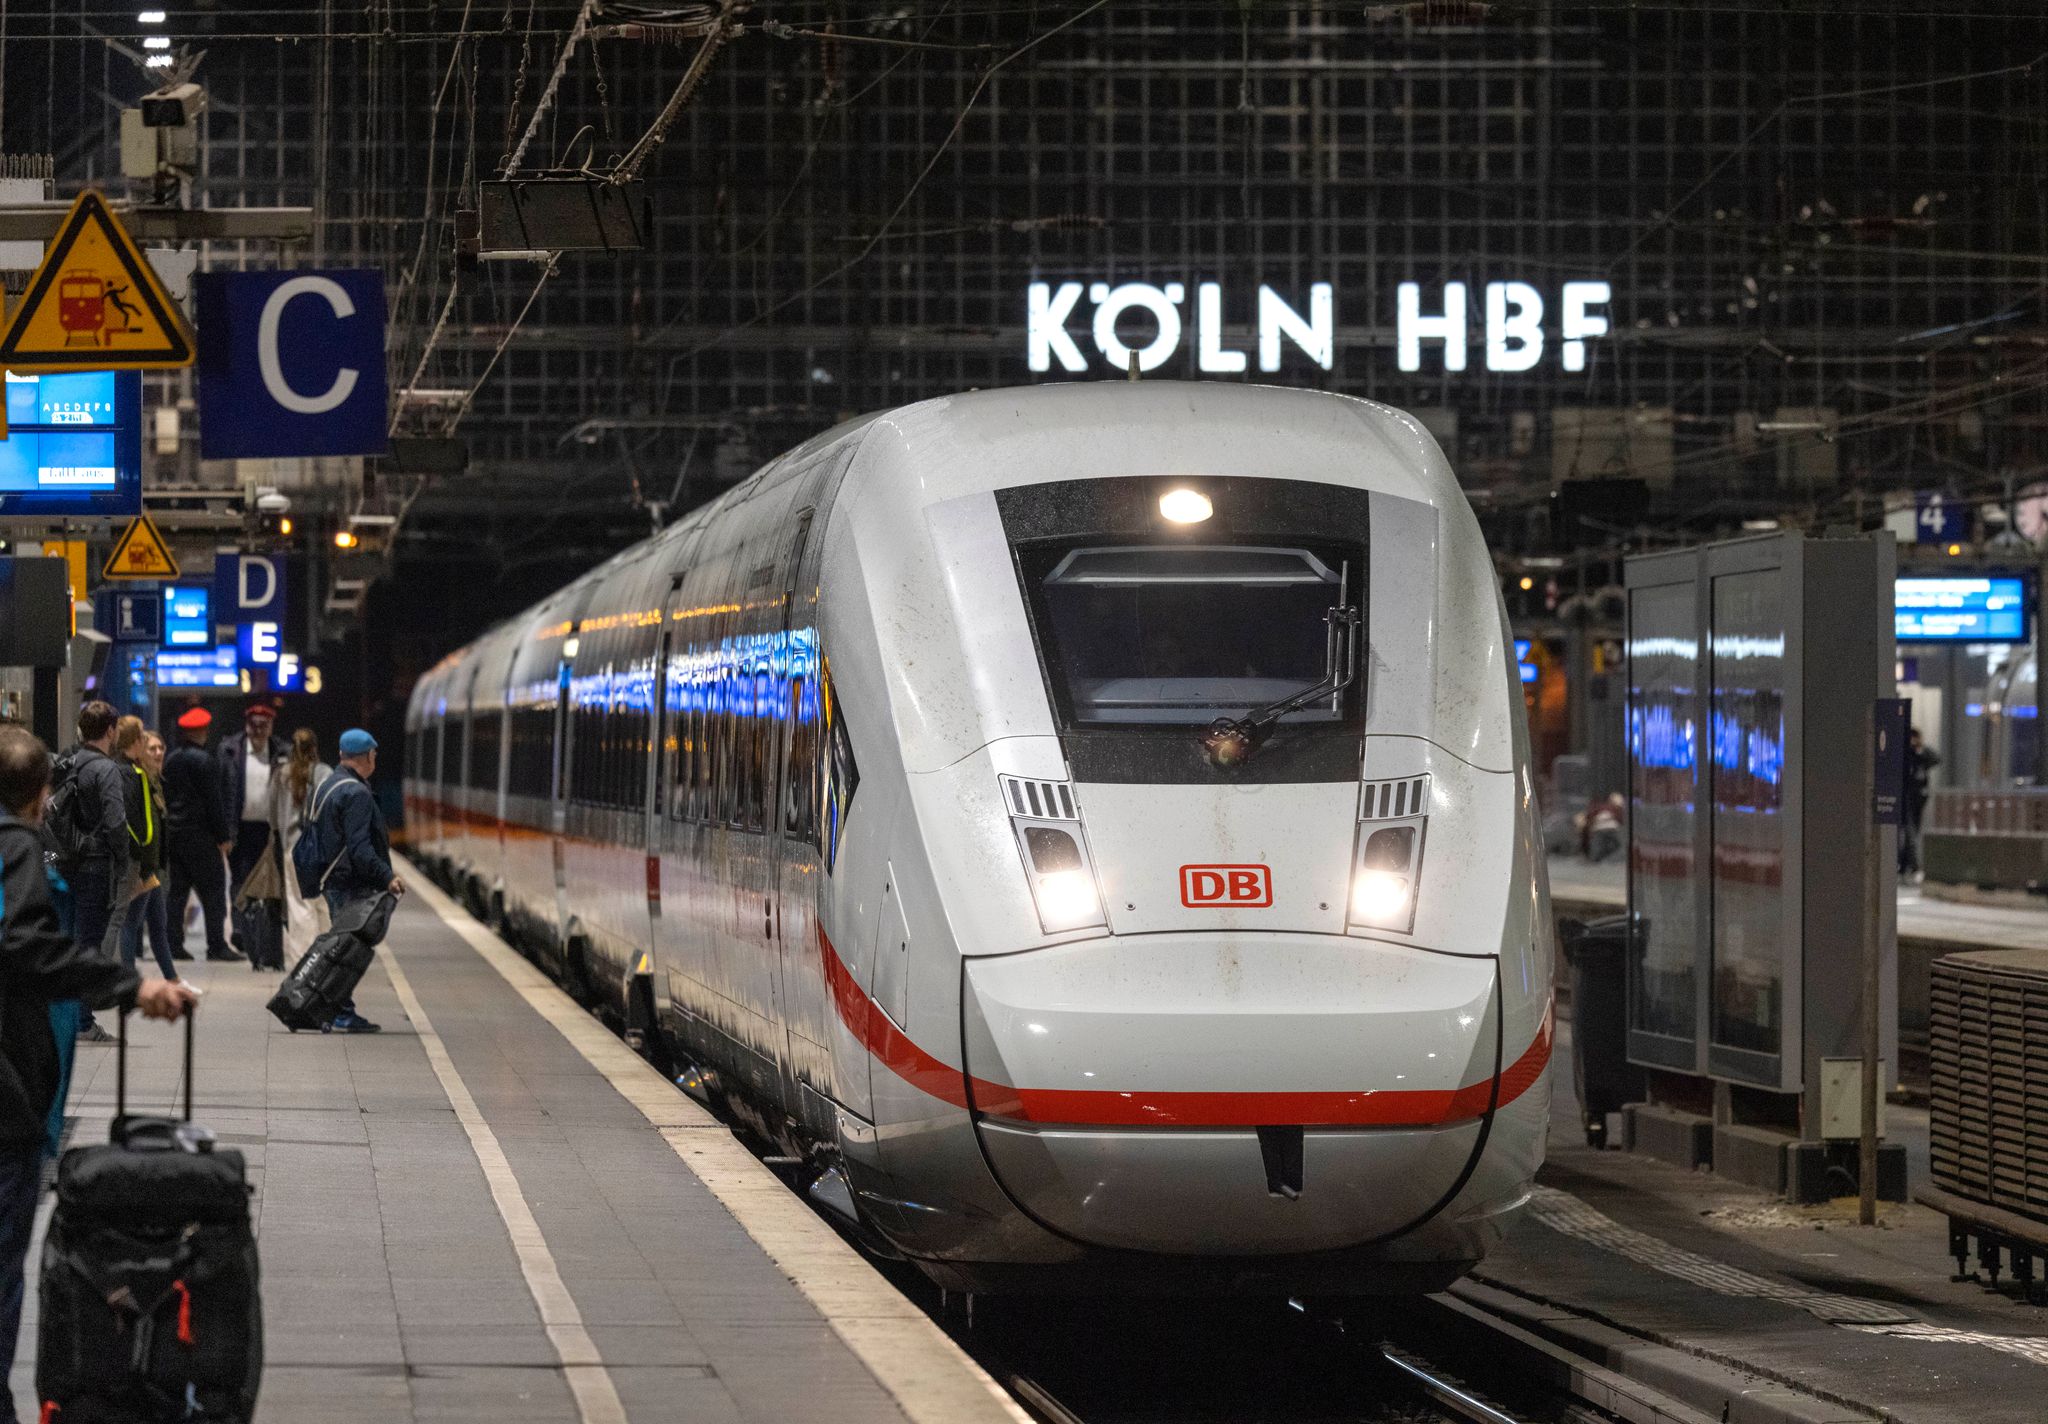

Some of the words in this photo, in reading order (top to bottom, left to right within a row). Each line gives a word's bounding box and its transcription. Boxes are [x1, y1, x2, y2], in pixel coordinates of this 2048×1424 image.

[258, 276, 359, 414] C
[1028, 282, 1333, 371] KÖLN
[1397, 282, 1611, 371] HBF
[1920, 493, 1946, 534] 4
[238, 555, 277, 608] D
[252, 622, 278, 663] E
[278, 653, 299, 687] F
[304, 666, 322, 694] 3
[1191, 871, 1262, 901] DB
